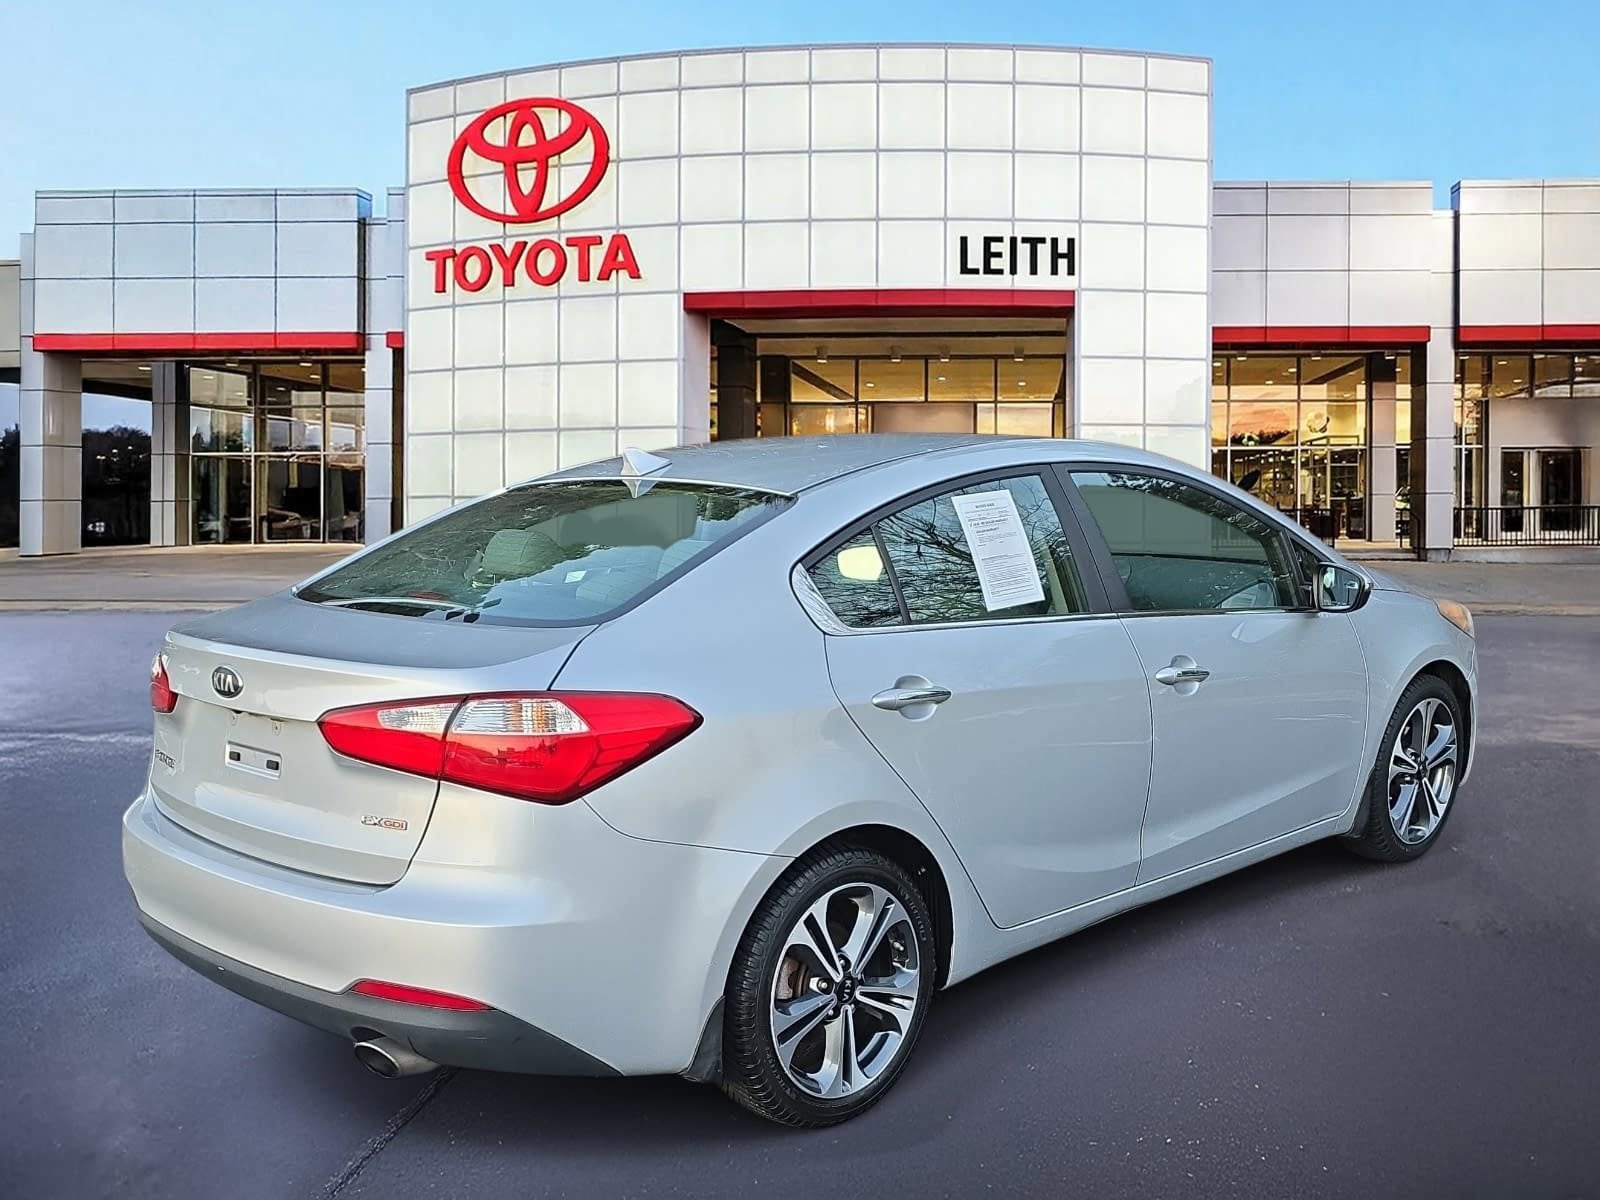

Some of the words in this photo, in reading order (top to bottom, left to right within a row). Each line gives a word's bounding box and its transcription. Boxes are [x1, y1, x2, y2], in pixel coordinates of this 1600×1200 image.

[425, 233, 642, 293] TOYOTA
[959, 235, 1076, 276] LEITH
[213, 671, 236, 693] KIA
[842, 980, 852, 1001] KIA
